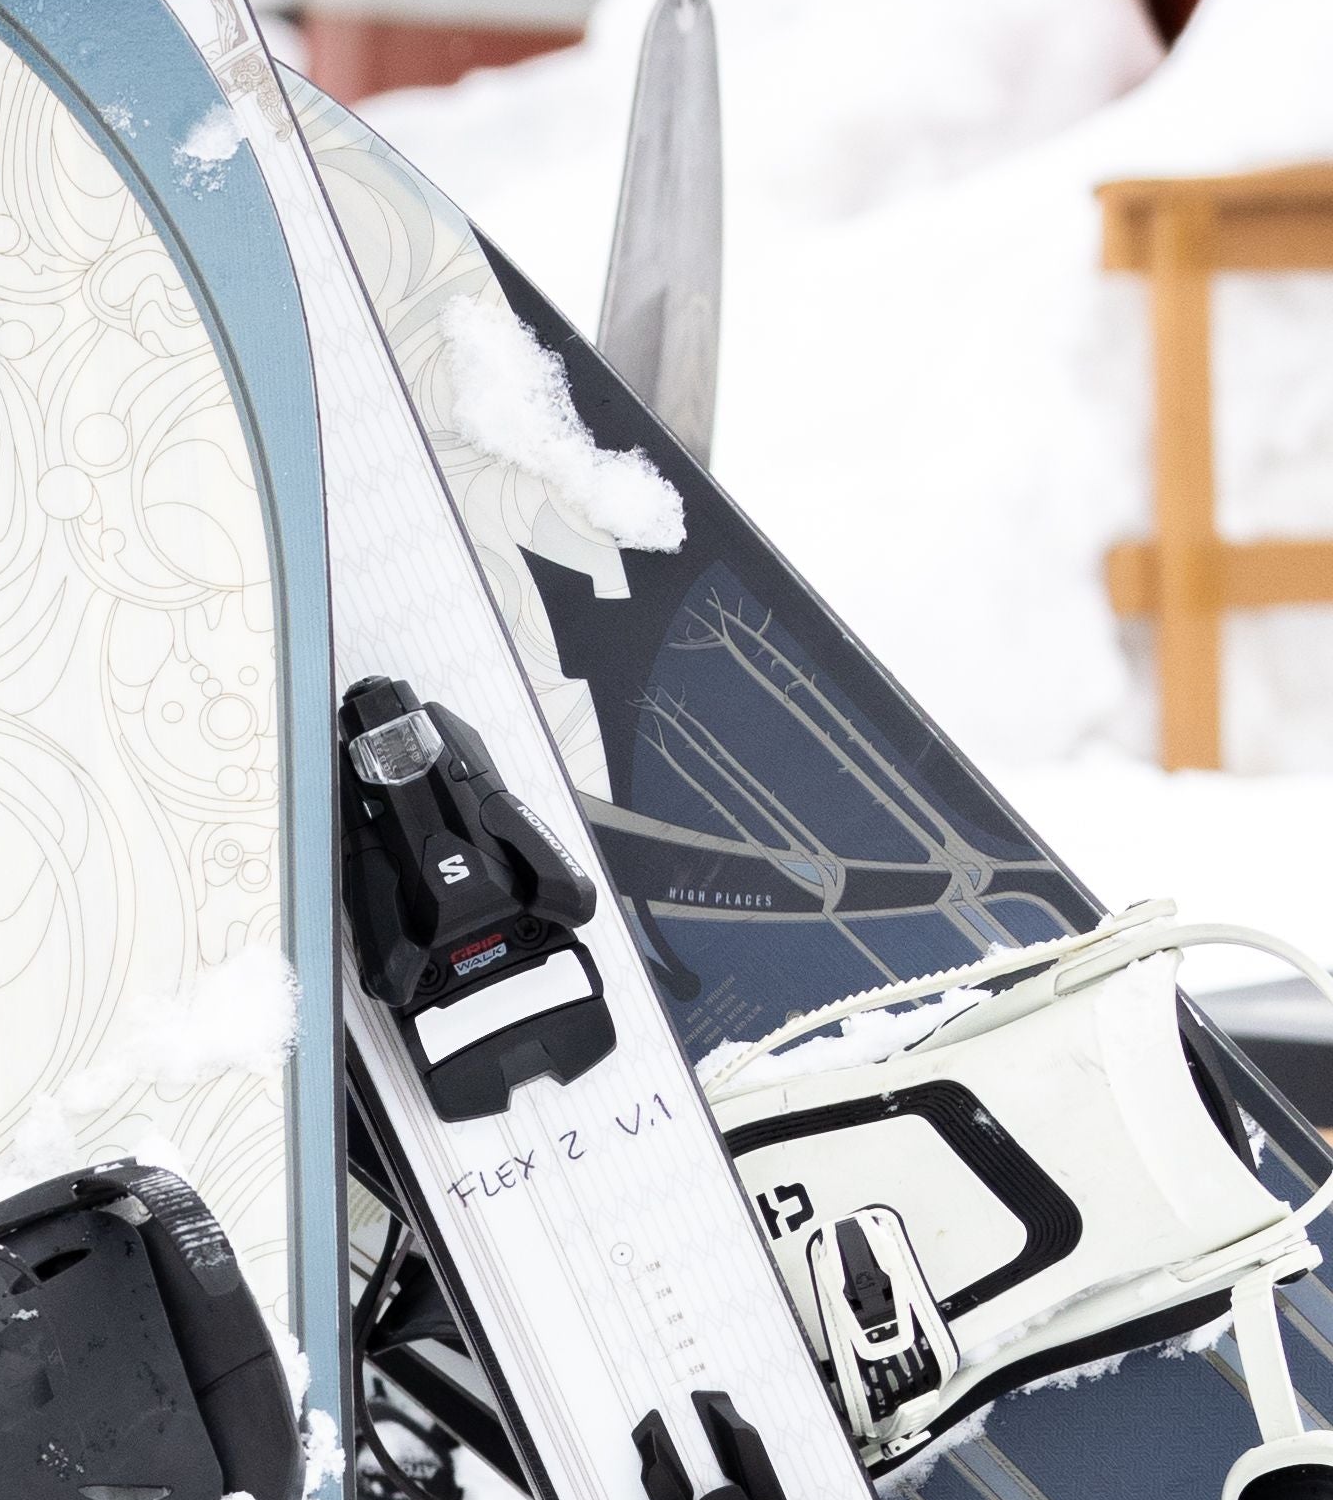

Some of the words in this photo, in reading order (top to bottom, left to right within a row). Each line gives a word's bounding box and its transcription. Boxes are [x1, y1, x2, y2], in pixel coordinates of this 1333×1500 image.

[516, 804, 586, 879] SALOMON
[668, 886, 706, 904] HIGH
[715, 891, 773, 908] PLACES
[449, 932, 504, 964] GRIP
[455, 944, 504, 973] WALK
[447, 1149, 535, 1209] FLEX
[615, 1092, 672, 1136] V.1
